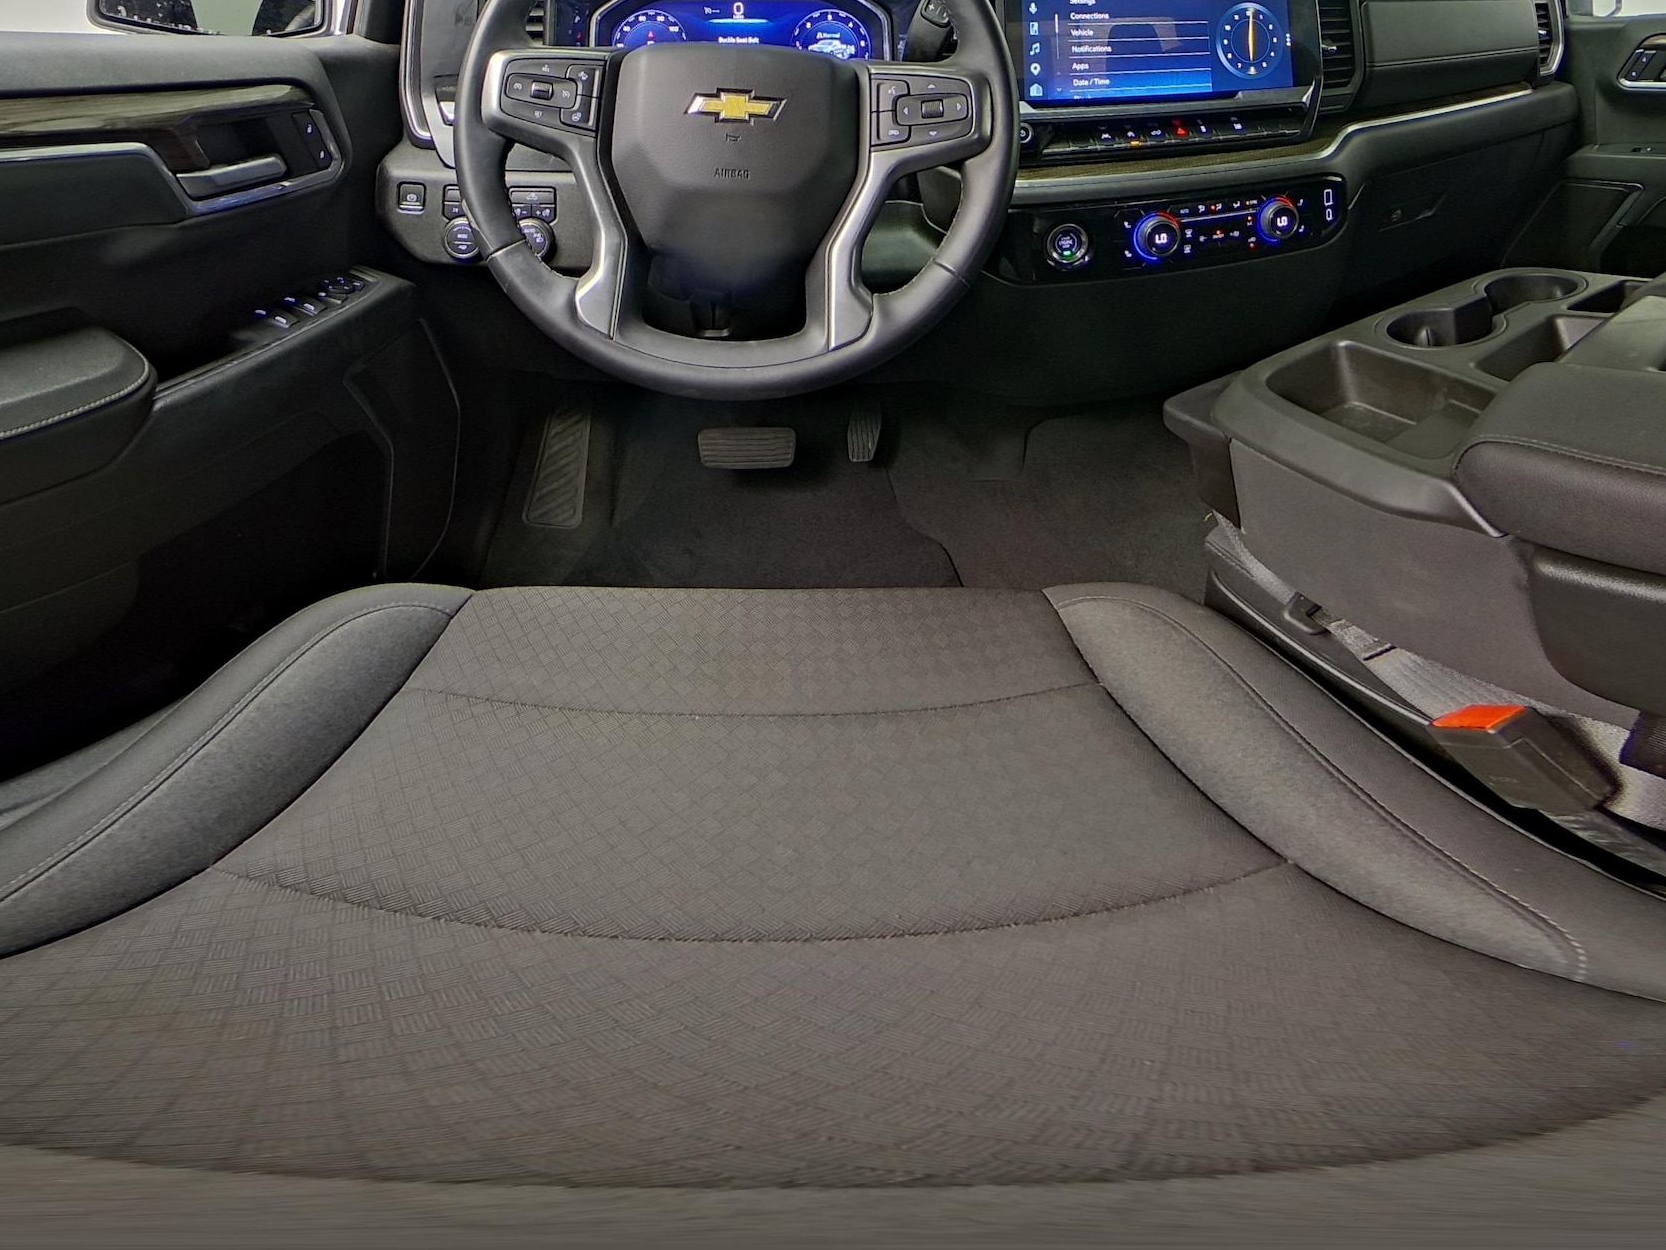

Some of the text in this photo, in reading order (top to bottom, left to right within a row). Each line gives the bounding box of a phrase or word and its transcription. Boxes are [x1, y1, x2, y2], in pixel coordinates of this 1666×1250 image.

[733, 2, 744, 15] 0
[1070, 12, 1109, 20] Connections
[718, 36, 735, 44] Buckle
[1072, 45, 1112, 53] Notifications
[1072, 62, 1089, 70] Apps
[1073, 78, 1089, 86] Date
[714, 168, 749, 179] AIRBAG
